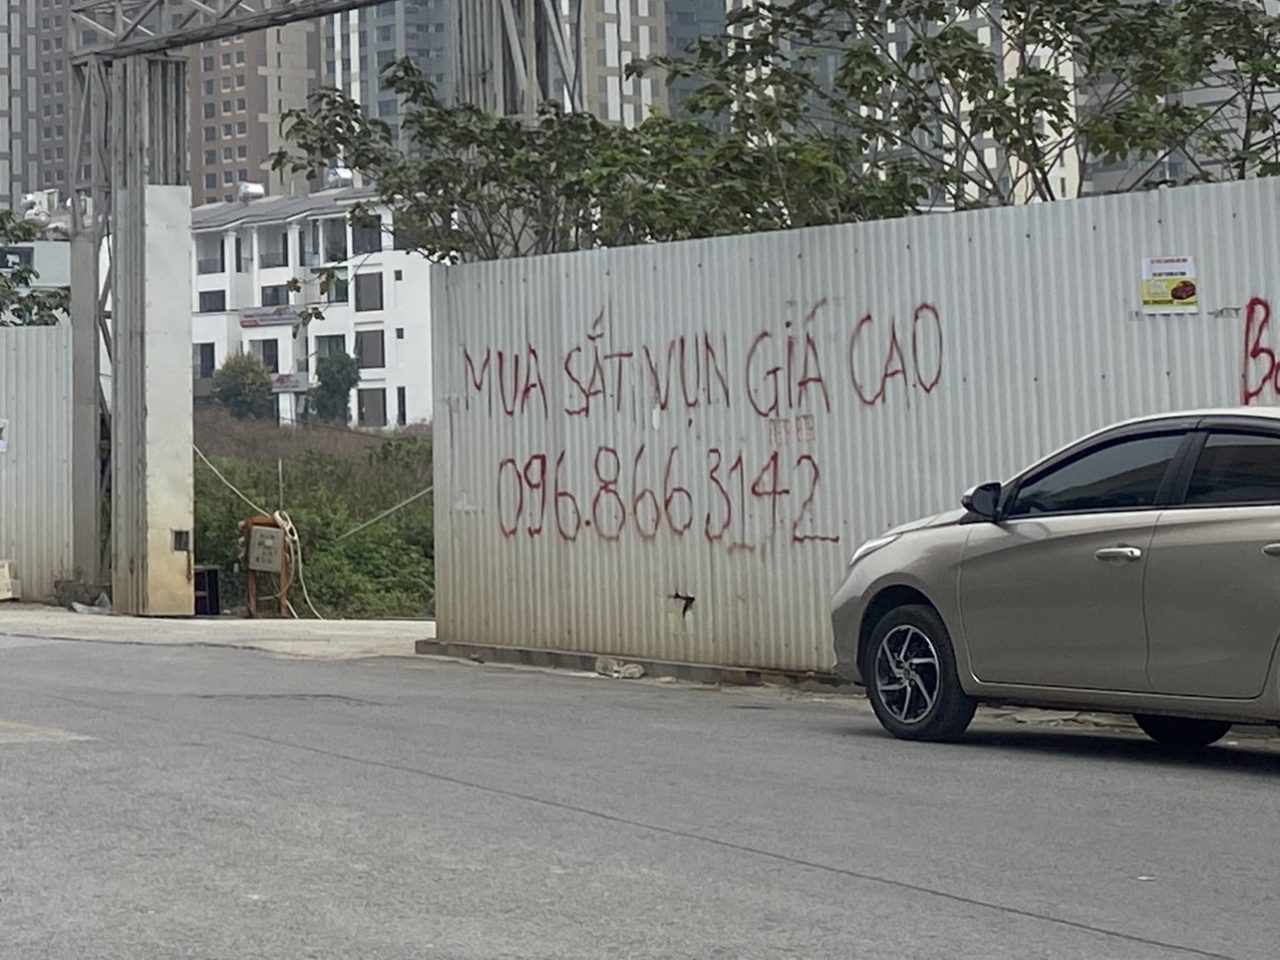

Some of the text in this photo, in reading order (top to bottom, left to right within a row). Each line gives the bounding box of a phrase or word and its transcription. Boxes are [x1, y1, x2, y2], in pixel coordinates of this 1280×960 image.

[463, 342, 548, 420] MUA
[564, 306, 633, 418] SẮT
[643, 328, 730, 428] VỤN
[849, 303, 943, 408] CAO
